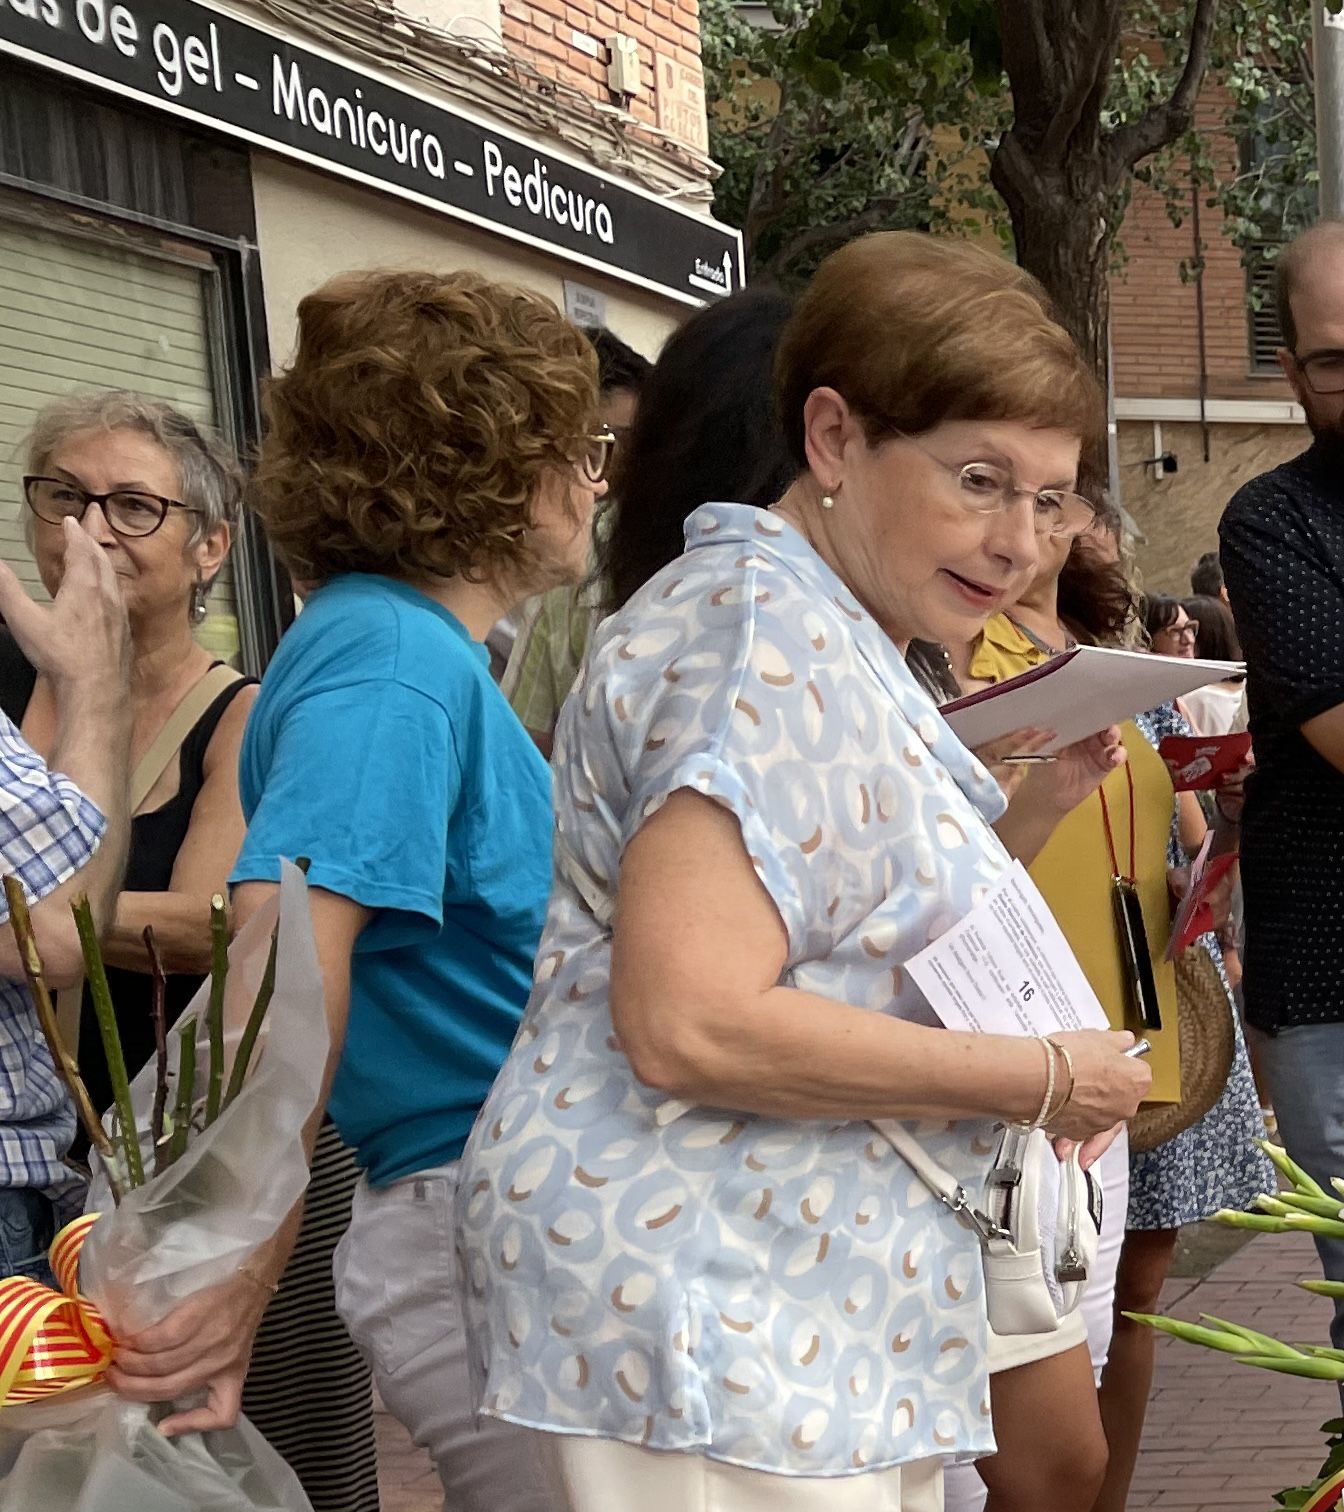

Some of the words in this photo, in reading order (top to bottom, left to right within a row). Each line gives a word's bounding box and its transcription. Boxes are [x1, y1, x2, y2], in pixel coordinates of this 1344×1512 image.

[75, 0, 138, 58] de
[152, 22, 223, 97] gel
[272, 52, 446, 179] Manicura
[483, 140, 614, 244] Pedicura
[1018, 980, 1035, 1002] 16
